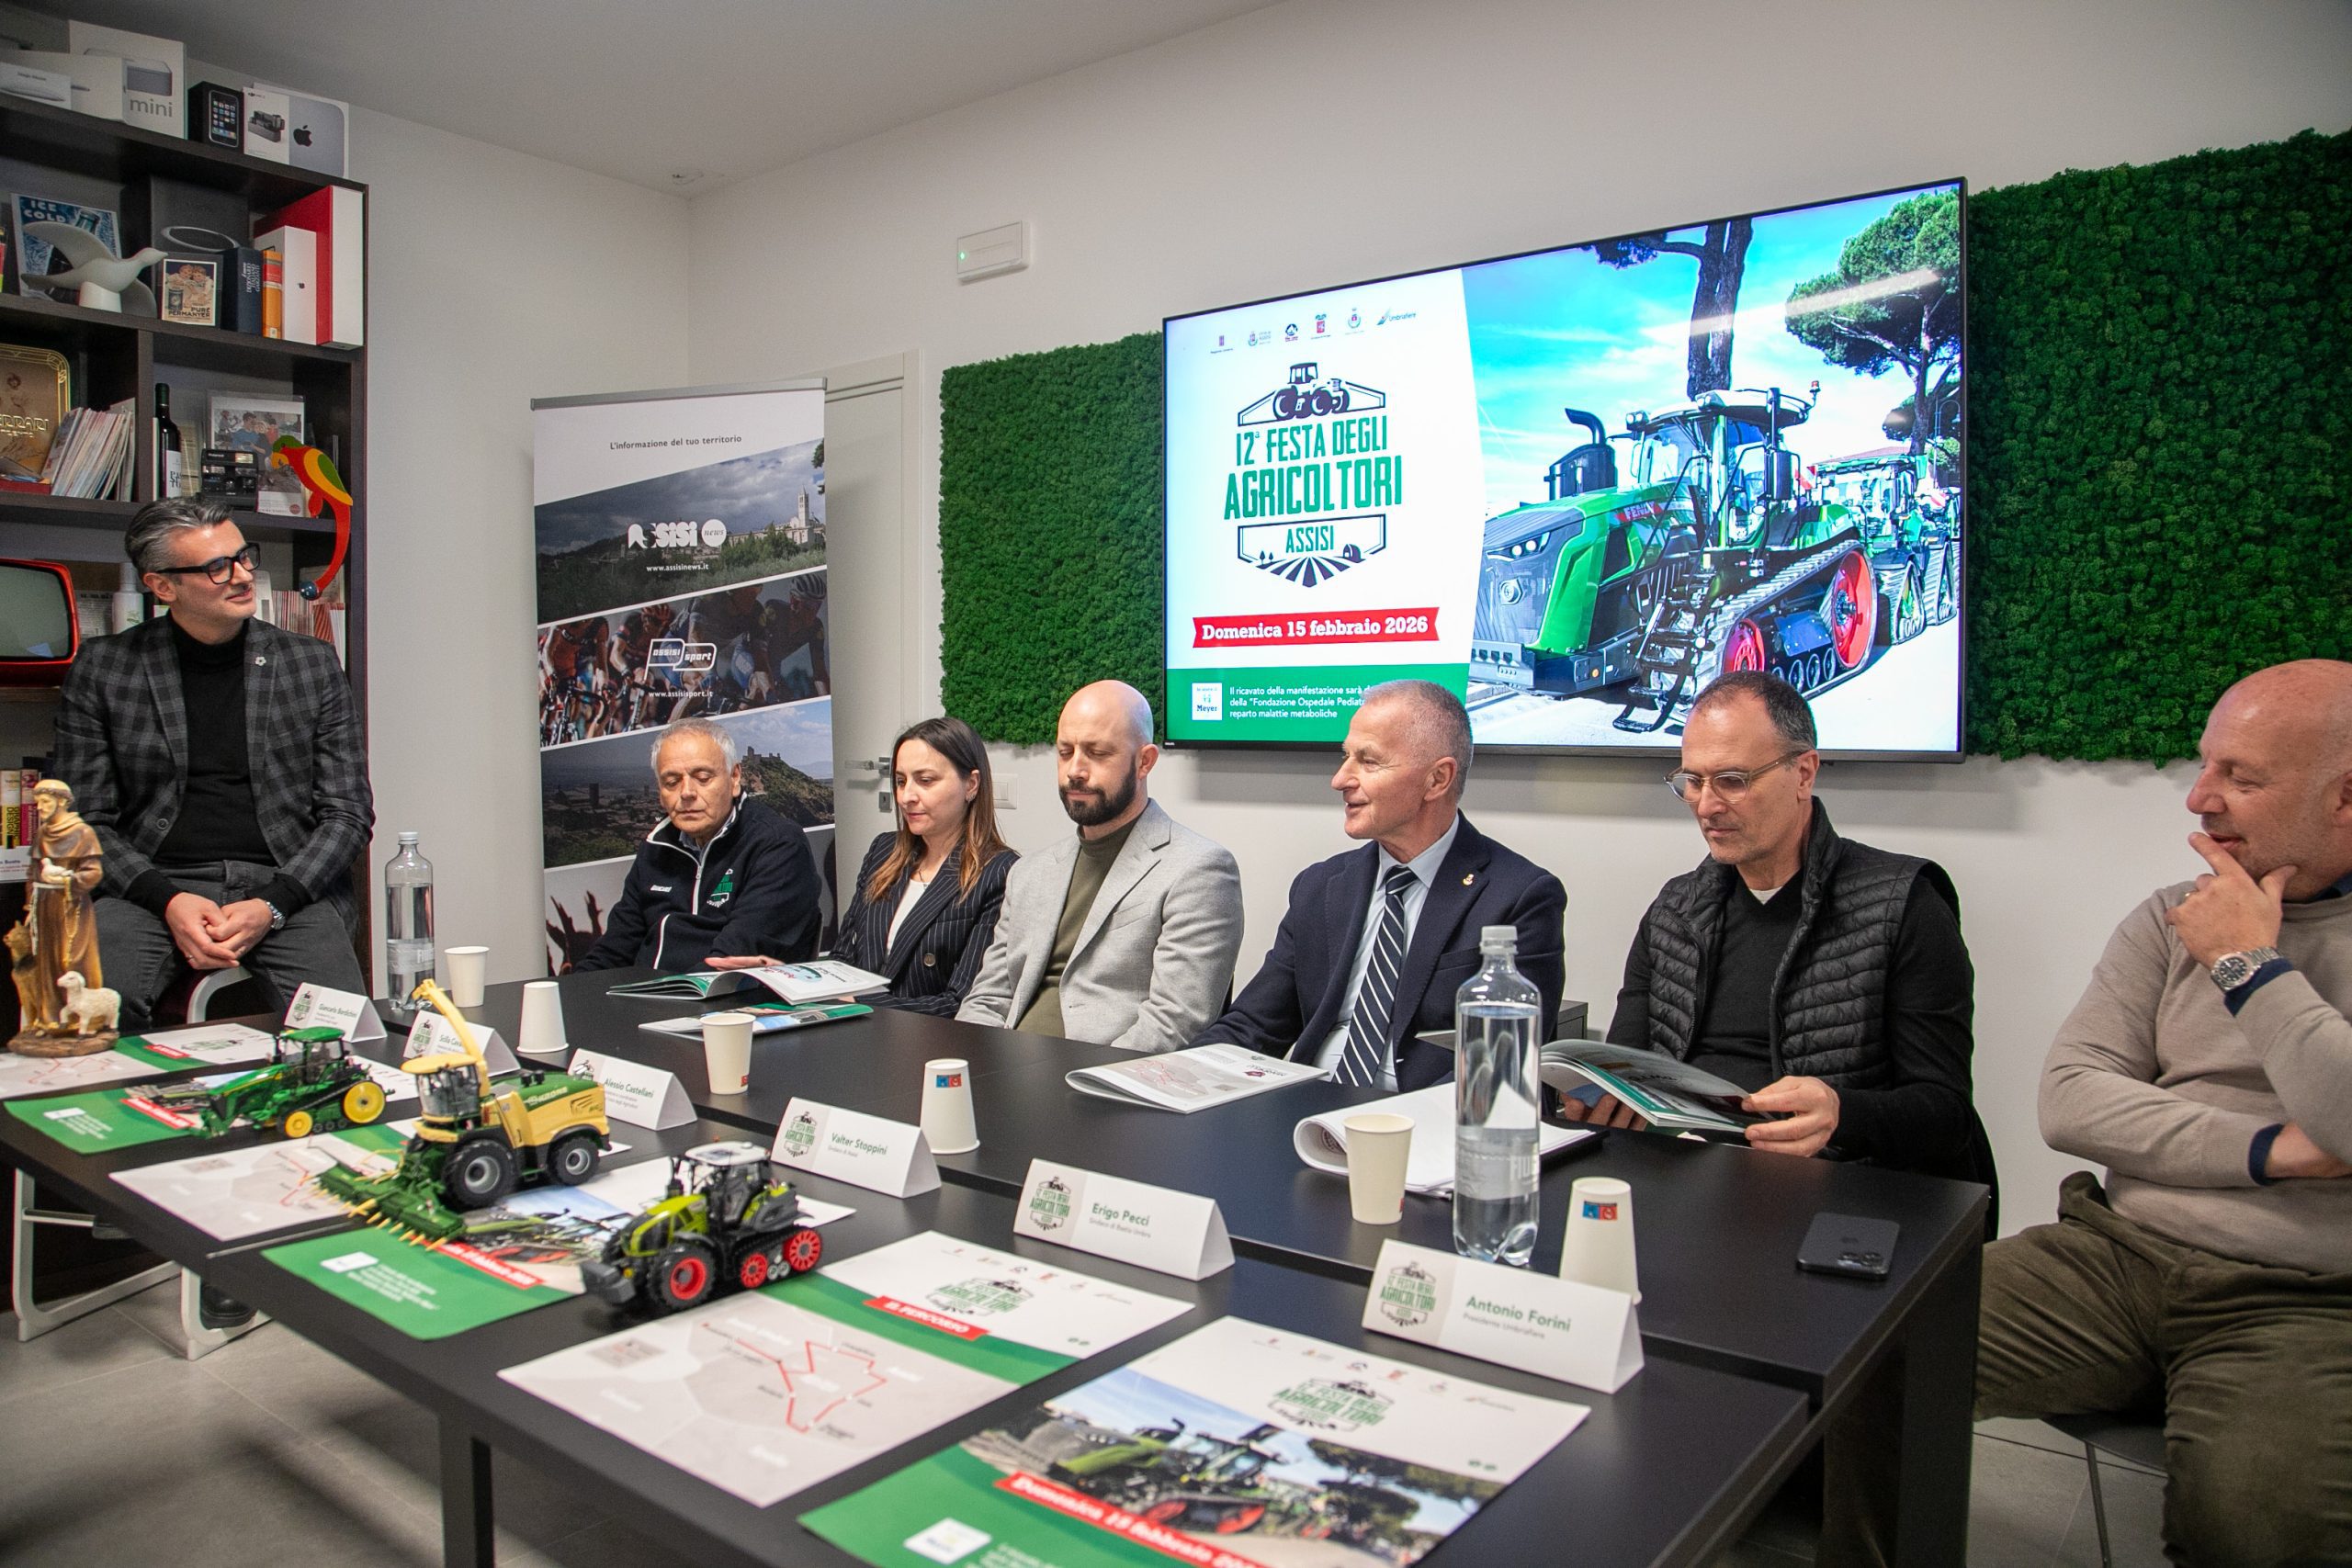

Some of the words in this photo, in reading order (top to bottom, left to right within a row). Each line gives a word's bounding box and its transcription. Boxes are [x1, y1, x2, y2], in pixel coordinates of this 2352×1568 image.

[130, 96, 173, 118] mini
[24, 209, 66, 223] COLD
[30, 200, 57, 212] ICE
[610, 439, 668, 450] L'informazione
[671, 438, 683, 446] del
[702, 435, 742, 445] territorio
[1267, 423, 1326, 463] FESTA
[1332, 415, 1387, 456] DEGLI
[1224, 455, 1402, 520] AGRICOLTORI
[1285, 525, 1334, 553] ASSISI
[646, 563, 709, 571] www.assisinews.it
[1202, 622, 1283, 640] Domenica
[1287, 620, 1306, 637] 15
[1310, 617, 1382, 636] febbraio
[1385, 616, 1429, 634] 2026
[684, 652, 712, 662] sport
[648, 690, 713, 698] www.assisisport.it
[1229, 687, 1235, 695] Il
[1236, 686, 1265, 695] ricavato
[1266, 686, 1284, 695] della
[1286, 685, 1344, 695] manifestazione
[1345, 685, 1363, 694] sarà
[1229, 698, 1248, 706] della
[1297, 697, 1334, 708] Ospedale
[1337, 697, 1365, 706] Pediatr
[1229, 710, 1257, 720] reparto
[1258, 709, 1288, 717] malattie
[1290, 709, 1338, 718] metaboliche
[604, 1077, 625, 1091] Alessio
[625, 1083, 655, 1099] Castellani
[831, 1132, 854, 1145] Valter
[854, 1139, 888, 1156] Stoppini
[1029, 1197, 1070, 1218] AGRICOLTORI
[1091, 1202, 1120, 1221] Erigo
[1122, 1209, 1149, 1226] Pecci
[1380, 1286, 1436, 1313] AGRICOLTORI
[1466, 1295, 1524, 1321] Antonio
[1527, 1310, 1572, 1332] Forini
[1273, 1387, 1385, 1427] AGRICOLTORI
[1012, 1476, 1104, 1521] Domenica
[1130, 1521, 1214, 1562] febbraio
